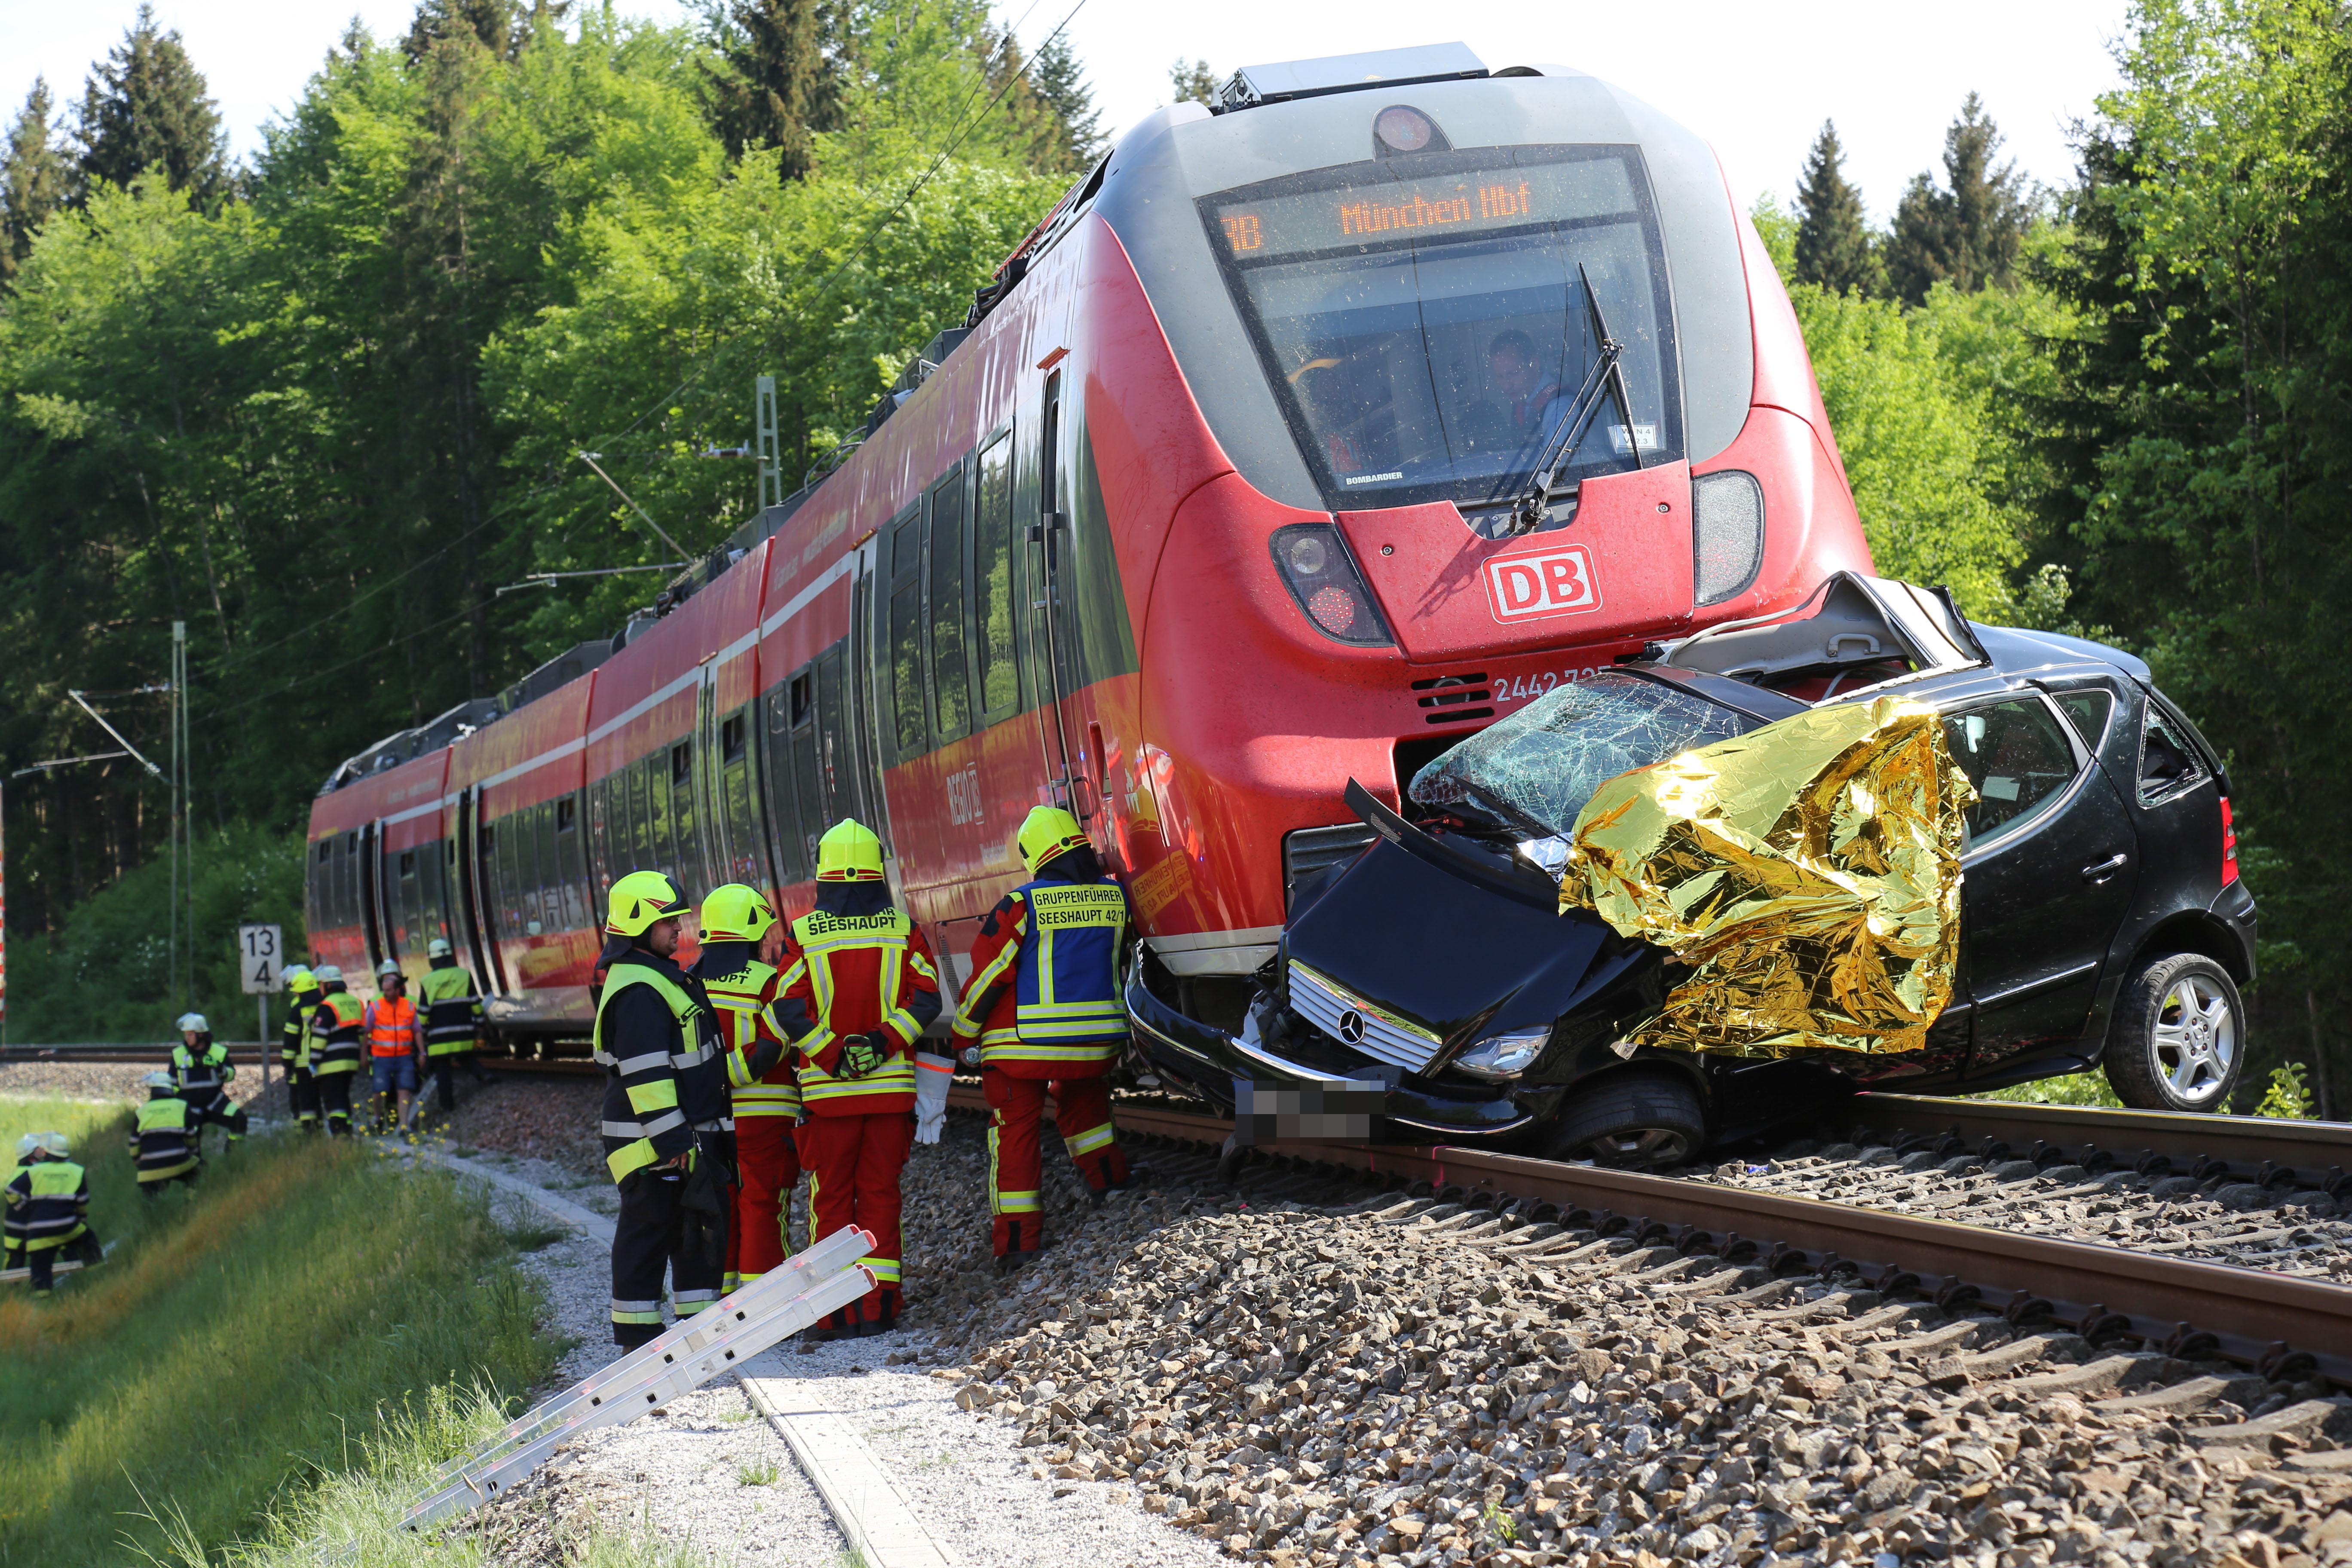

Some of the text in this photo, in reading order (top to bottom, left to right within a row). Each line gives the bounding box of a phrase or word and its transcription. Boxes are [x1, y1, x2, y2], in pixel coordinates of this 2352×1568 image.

[1341, 196, 1470, 235] München
[1479, 182, 1531, 218] Hbf
[1346, 472, 1403, 485] BOMBARDIER
[1498, 558, 1585, 611] DB
[1494, 672, 1557, 702] 2442
[946, 770, 973, 826] REGIO
[1035, 887, 1122, 906] GRUPPENFÜHRER
[808, 916, 896, 936] SEESHAUPT
[1038, 910, 1124, 925] SEESHAUPT 42/1
[247, 930, 274, 956] 13
[254, 960, 272, 986] 4
